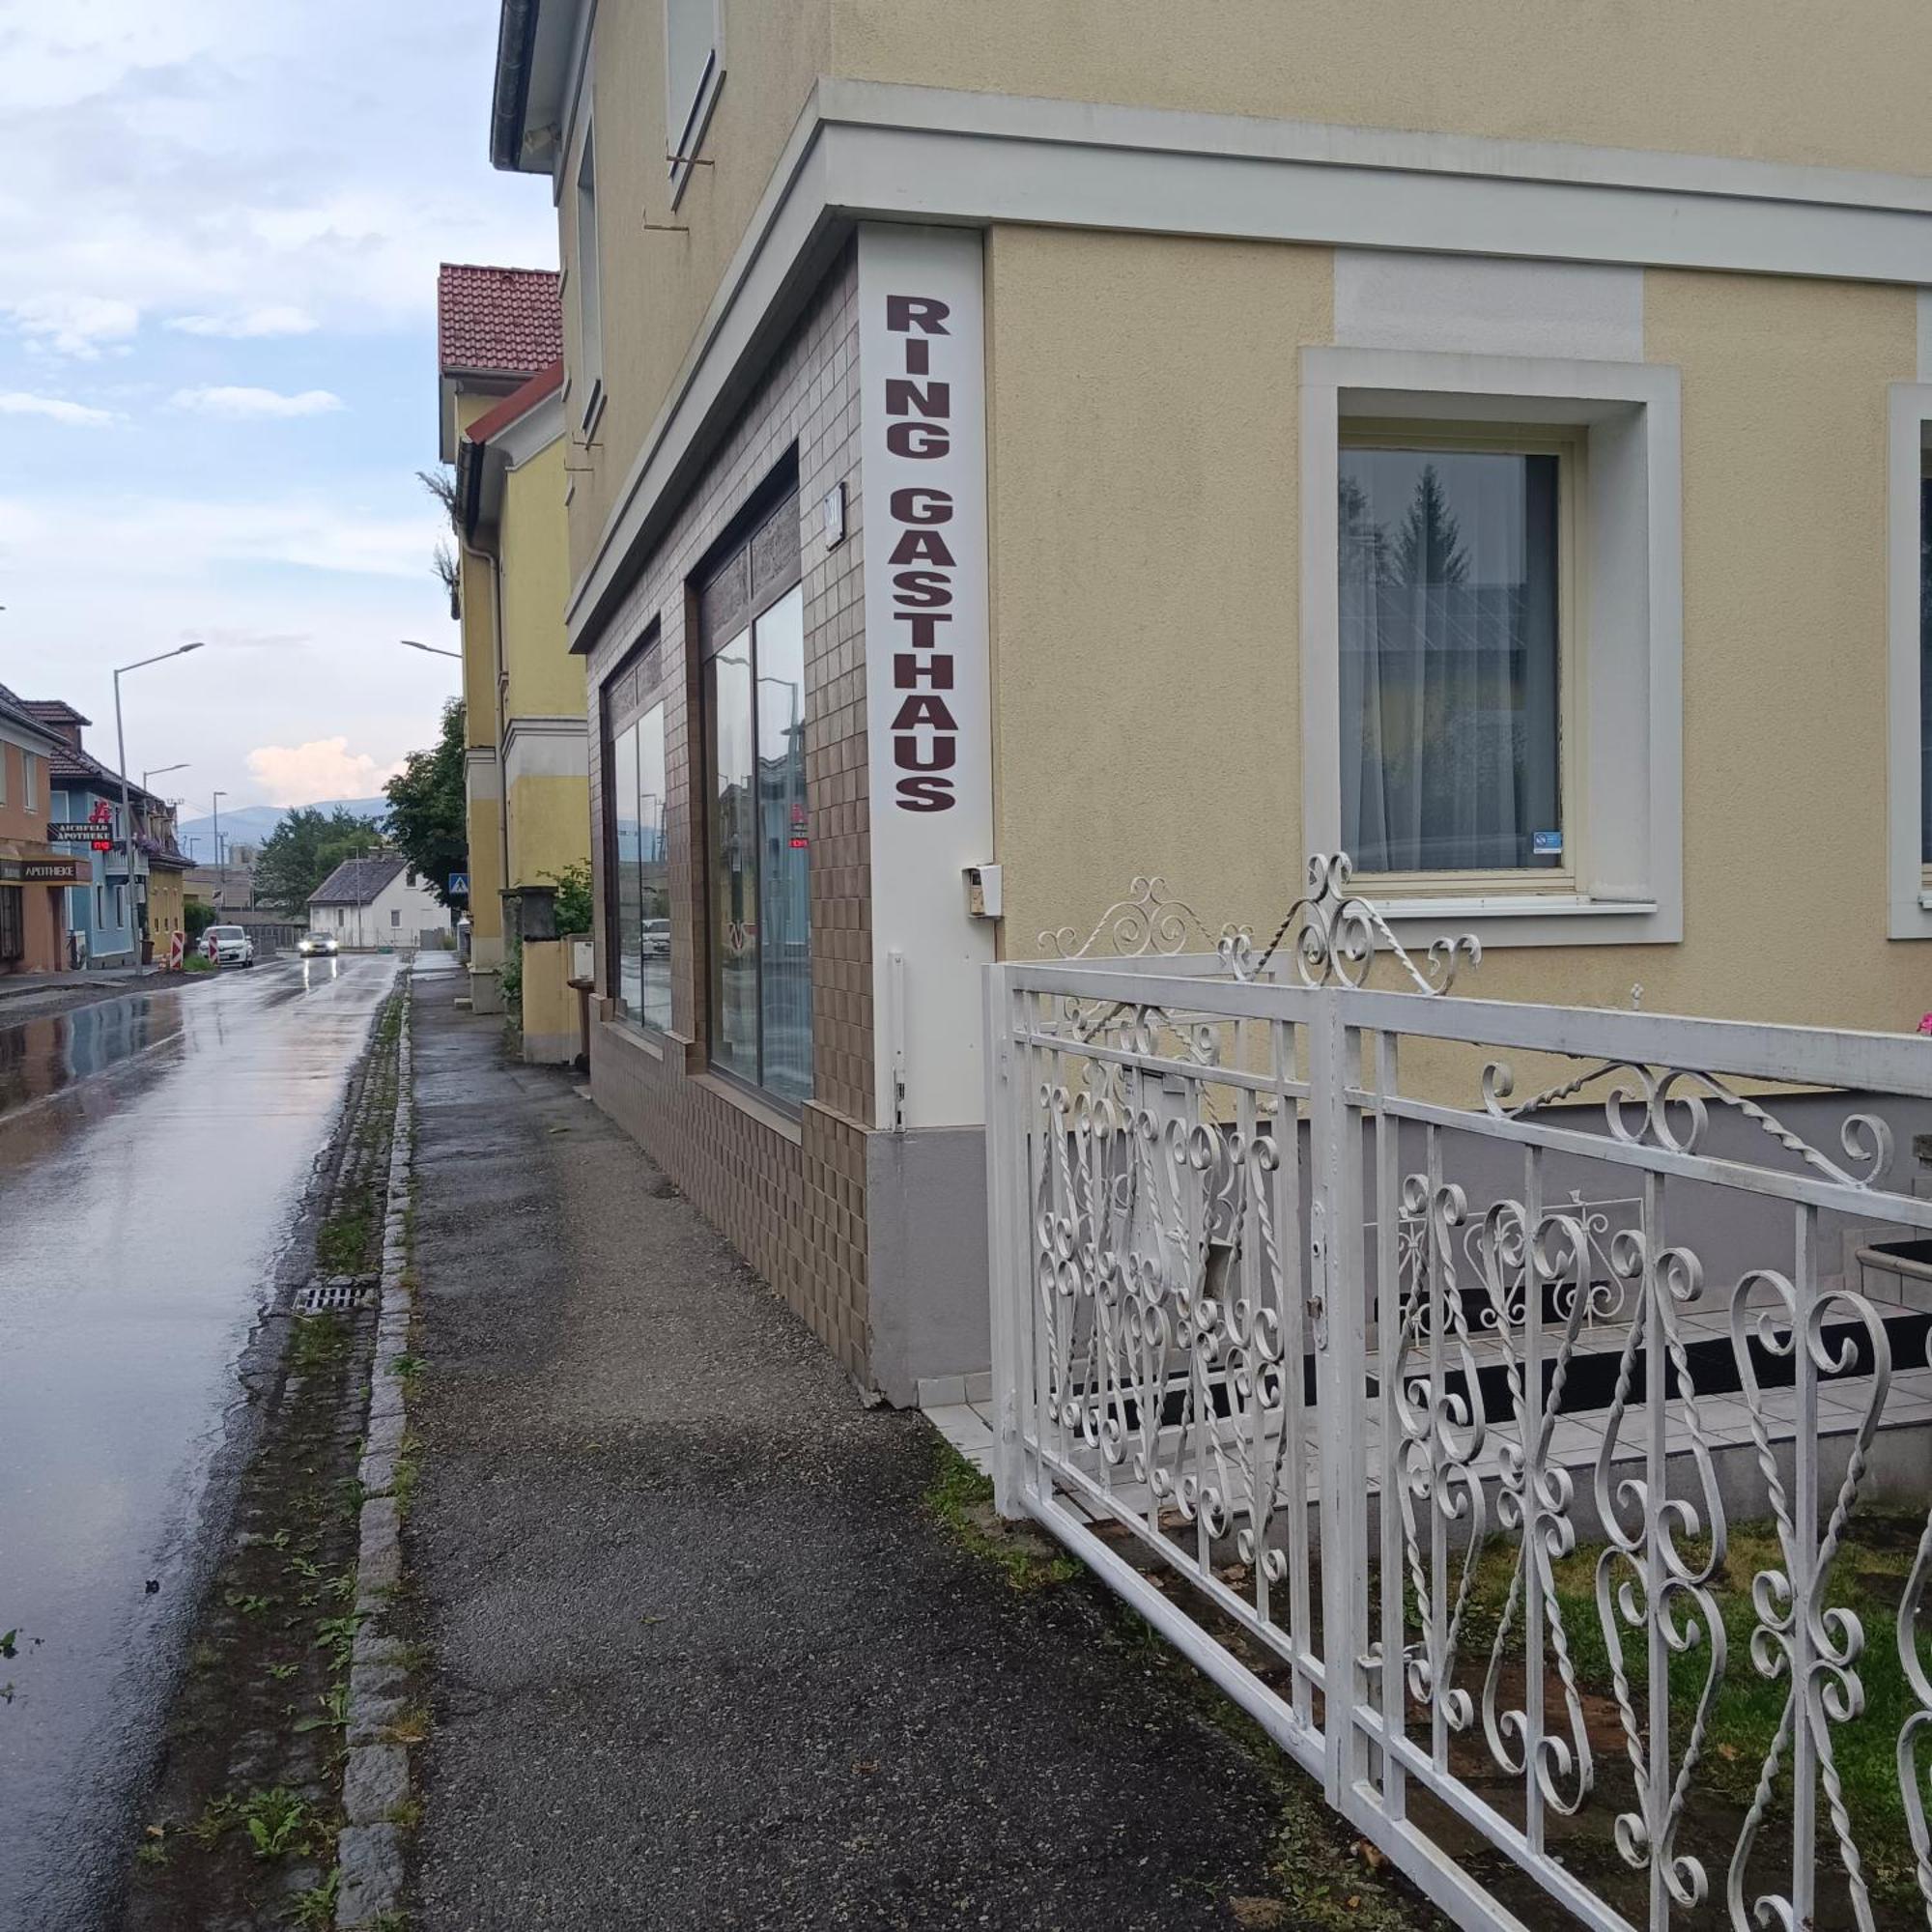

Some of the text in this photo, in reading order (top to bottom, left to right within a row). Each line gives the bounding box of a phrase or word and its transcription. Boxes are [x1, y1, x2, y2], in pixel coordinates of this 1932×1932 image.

[886, 296, 958, 811] RING GASTHAUS
[25, 866, 74, 876] APOTHEKE
